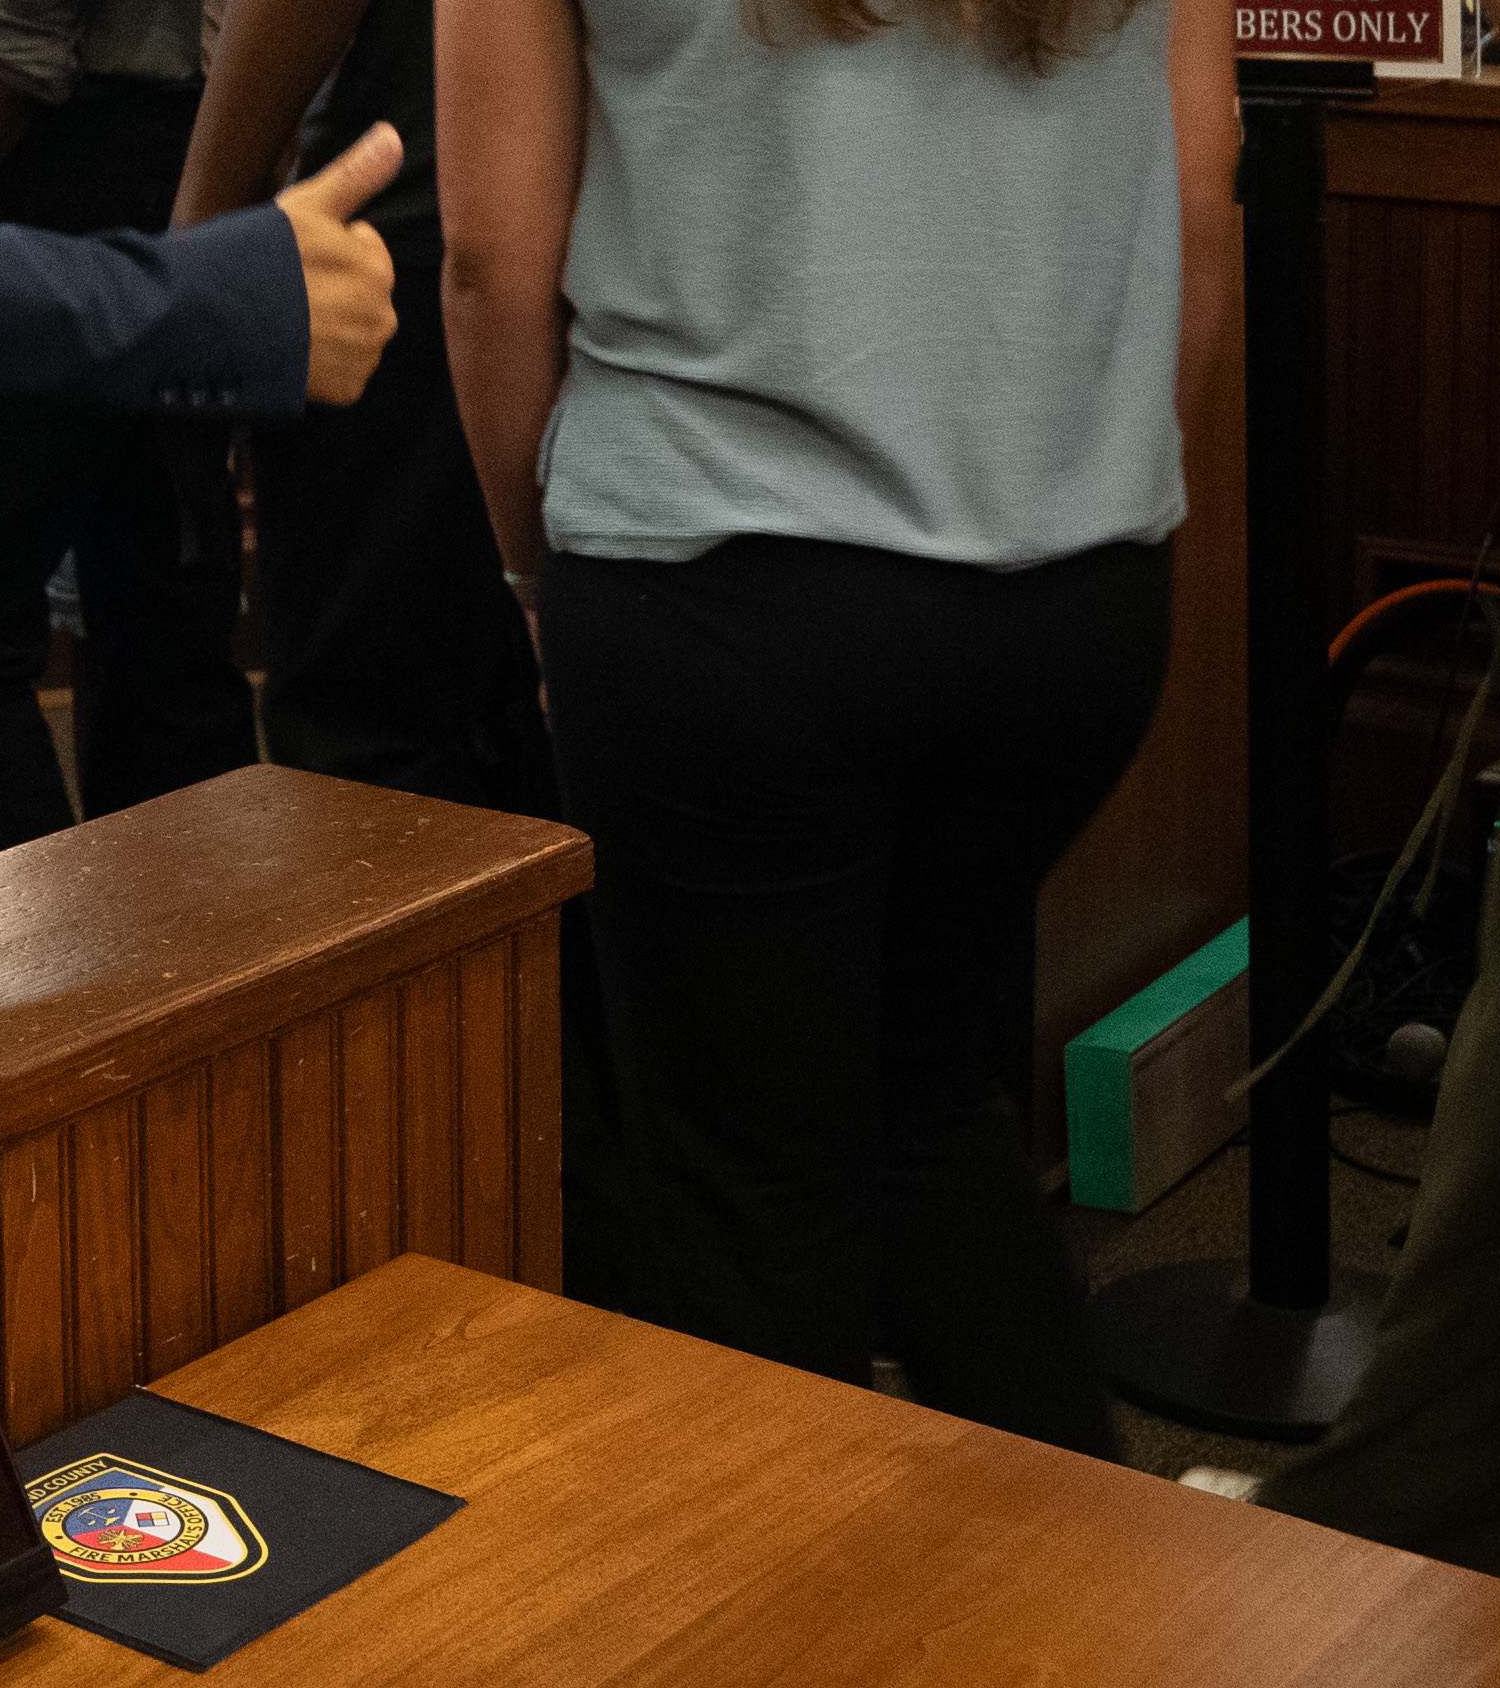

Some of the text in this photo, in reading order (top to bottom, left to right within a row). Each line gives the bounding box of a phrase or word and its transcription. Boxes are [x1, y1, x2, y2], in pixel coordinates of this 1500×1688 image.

[1236, 8, 1430, 45] BERS ONLY
[28, 1459, 108, 1503] ND COUNTY
[64, 1492, 102, 1508] 1985
[69, 1493, 203, 1563] FIRE MARSHAL'S OFFICE
